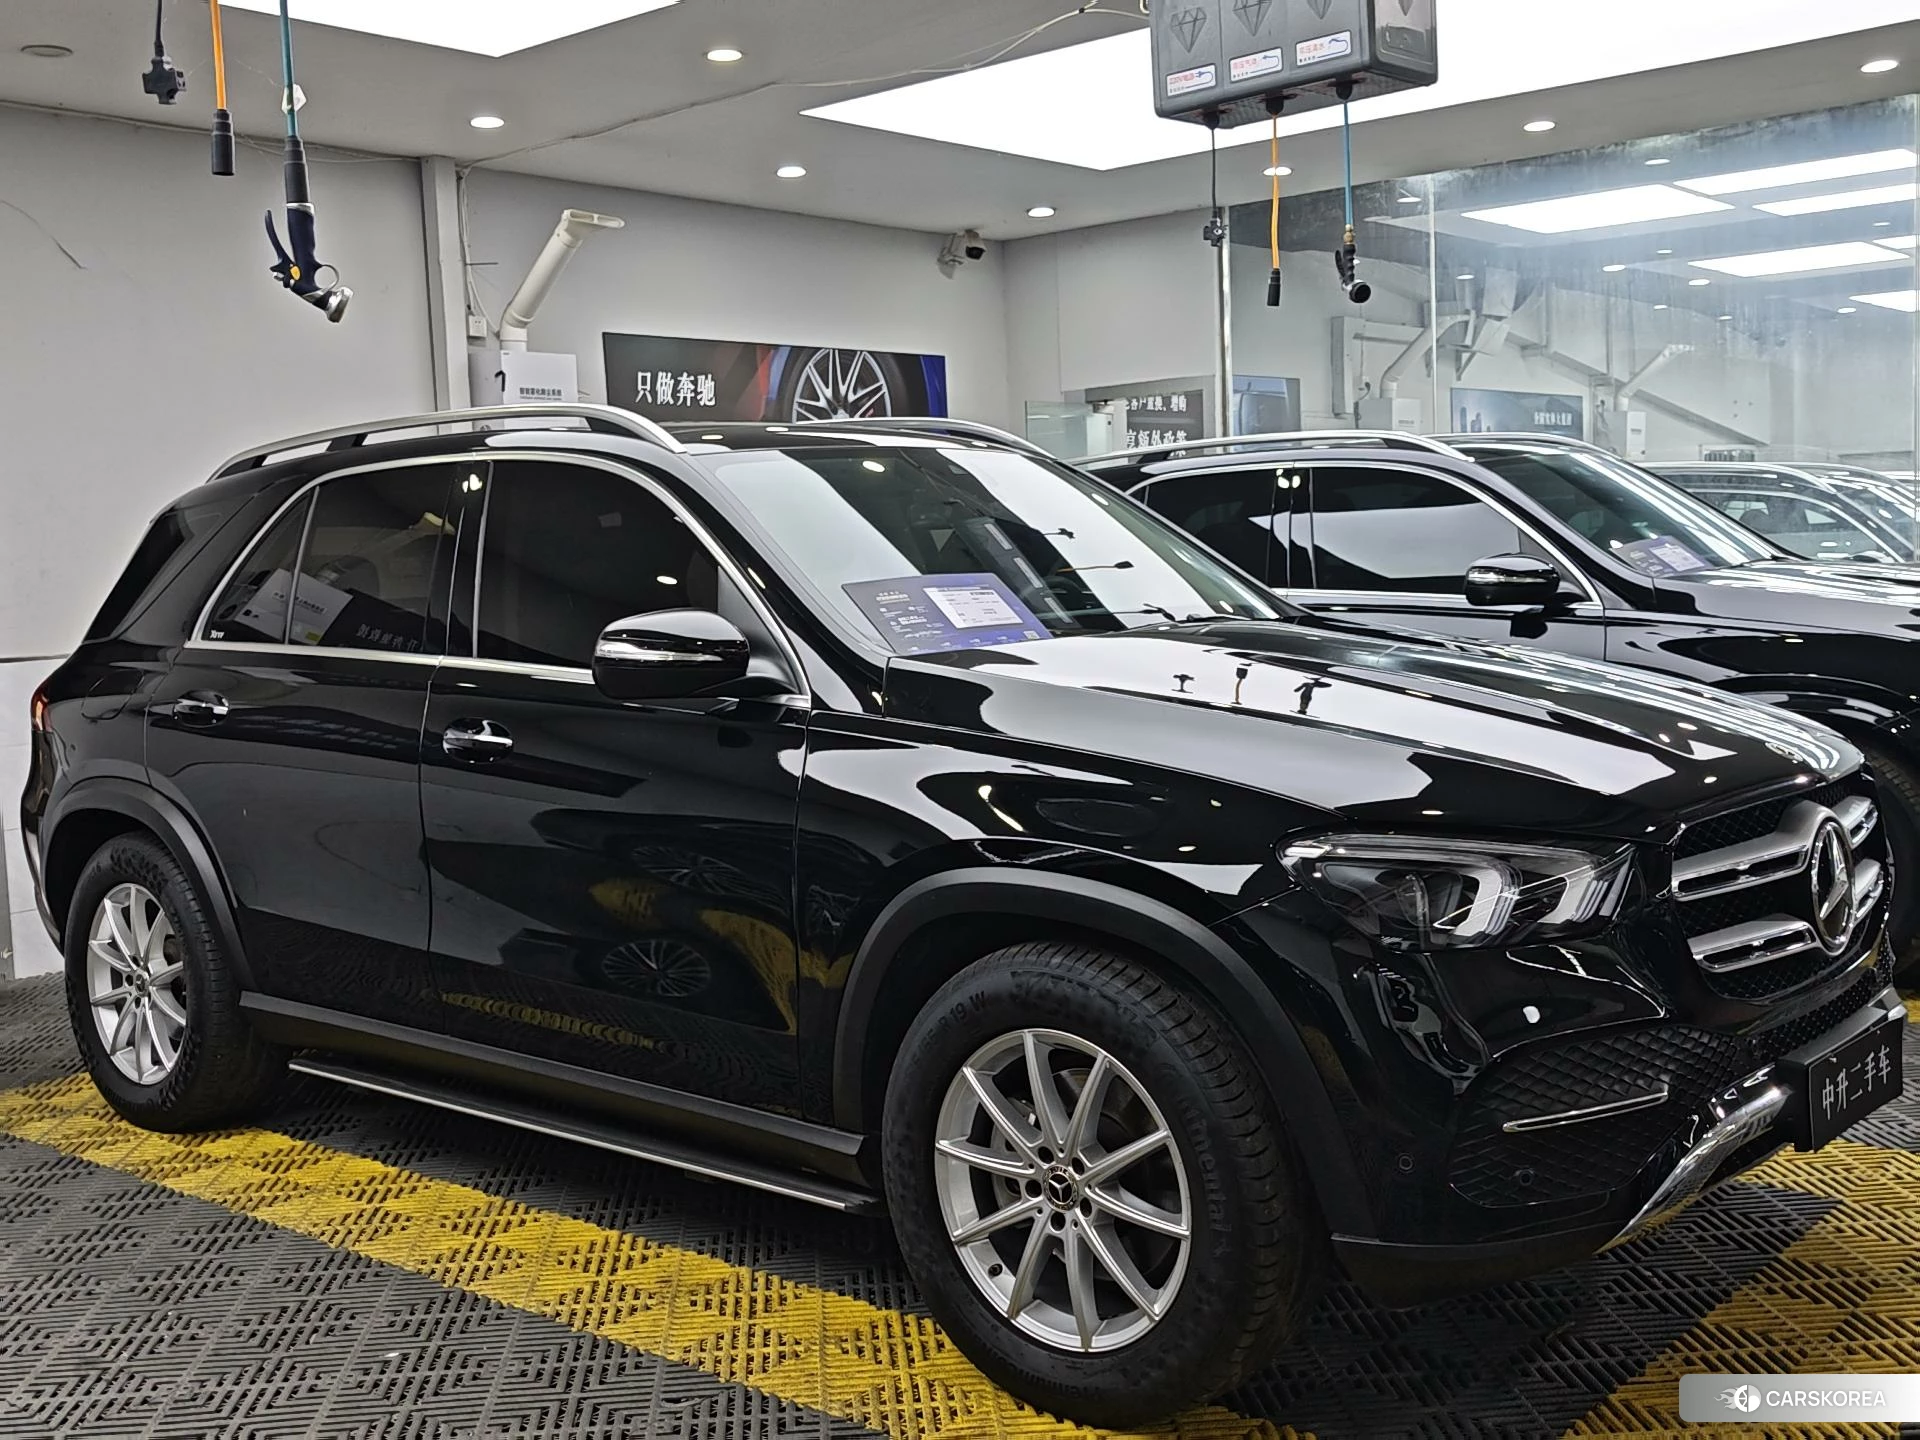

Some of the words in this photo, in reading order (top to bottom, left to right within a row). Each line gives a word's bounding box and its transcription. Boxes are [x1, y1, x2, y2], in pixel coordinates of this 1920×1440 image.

[635, 371, 716, 407] 只做奔驰
[1822, 1044, 1892, 1121] 中升二手车
